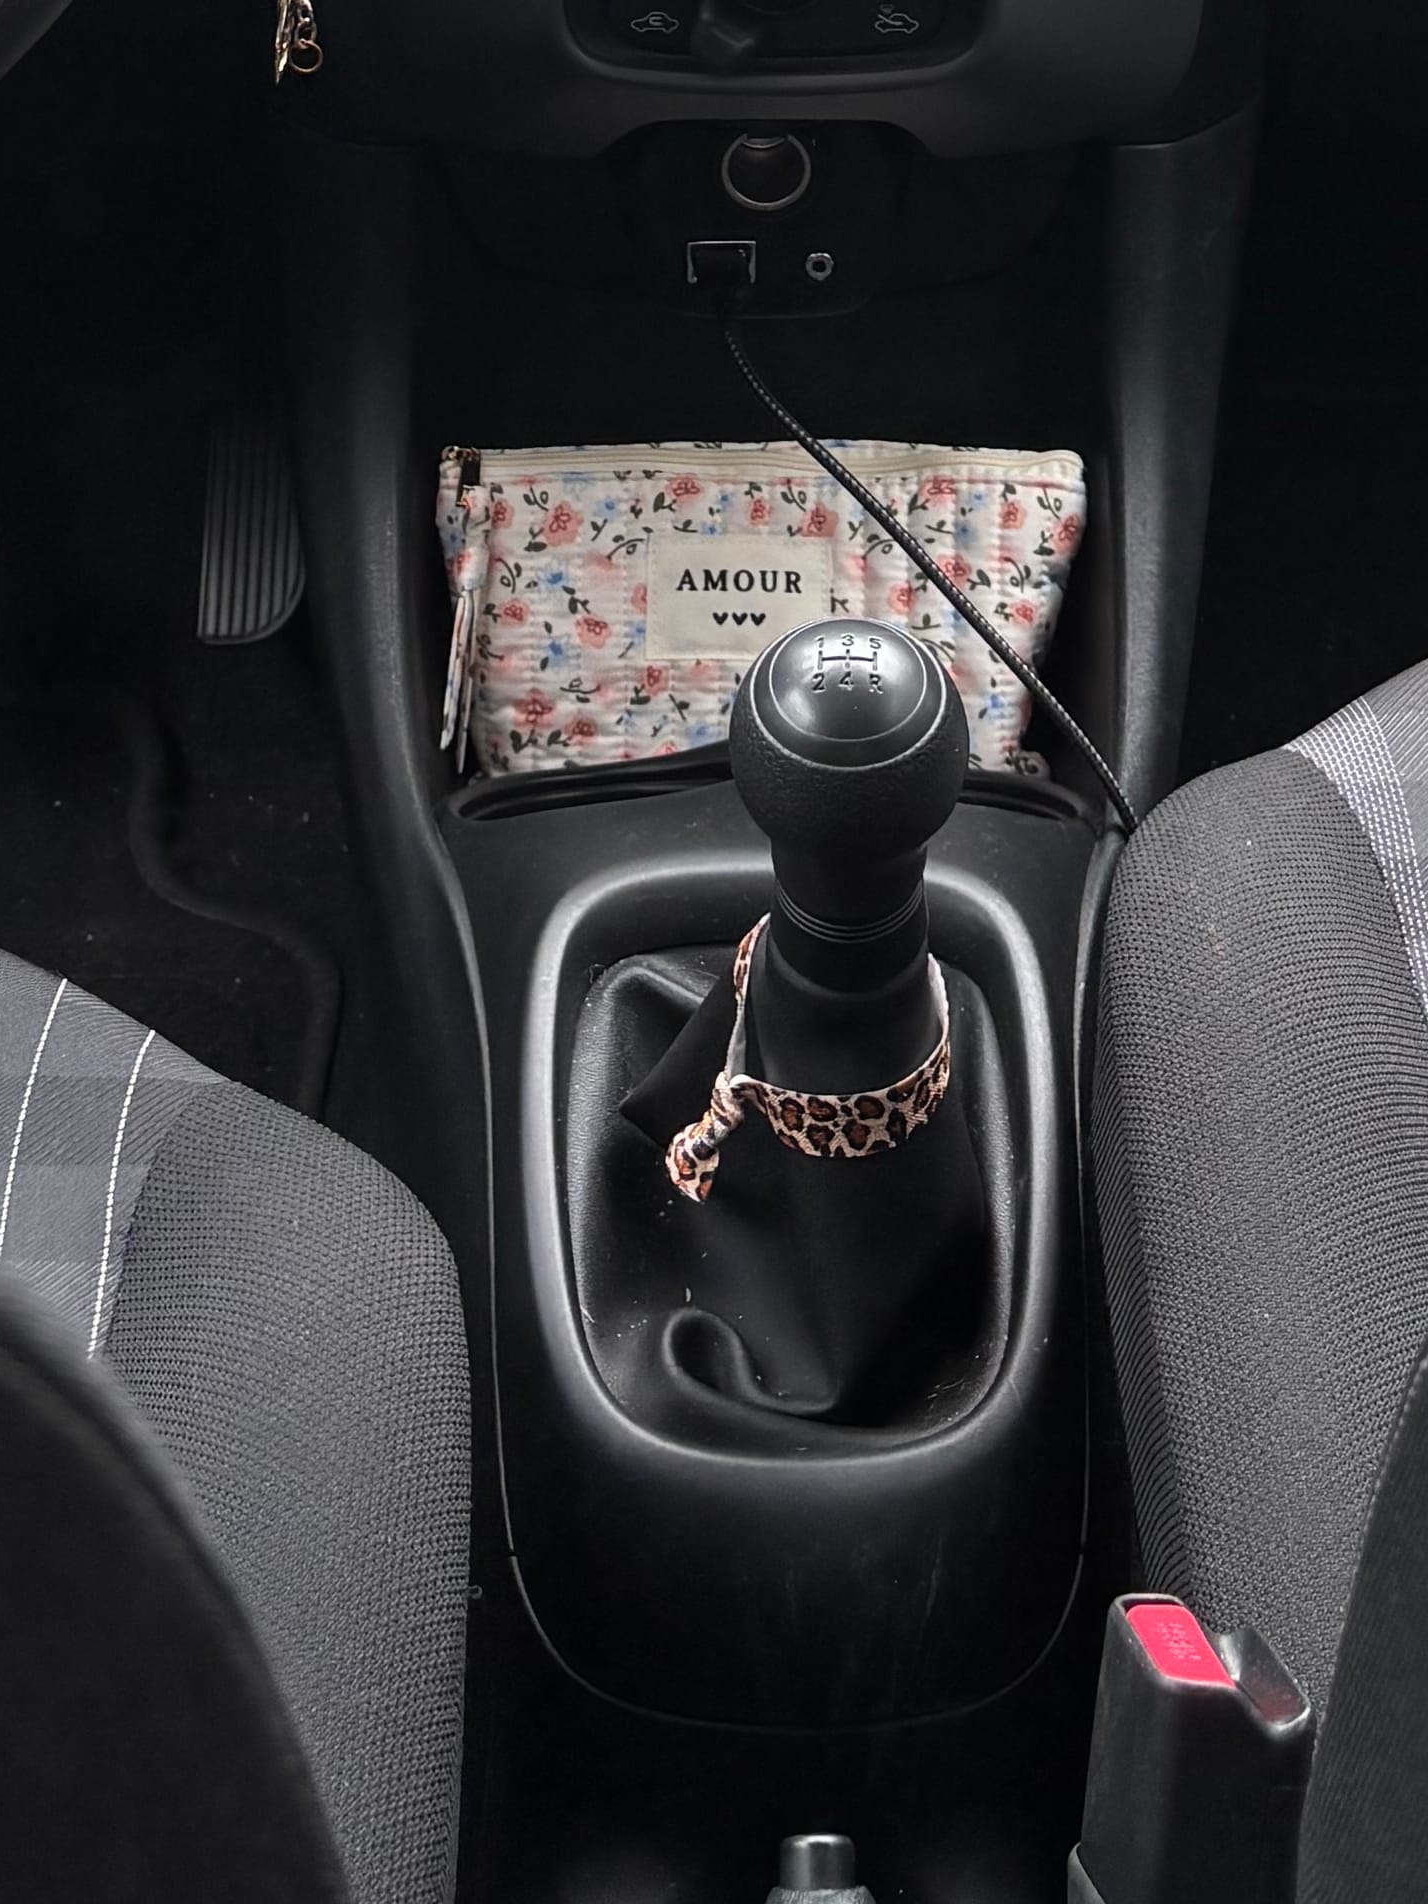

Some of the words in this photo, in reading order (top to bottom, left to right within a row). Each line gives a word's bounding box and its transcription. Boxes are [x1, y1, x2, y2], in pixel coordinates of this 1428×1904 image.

[675, 568, 803, 594] AMOUR
[816, 636, 825, 648] 1
[840, 633, 855, 647] 3
[868, 636, 882, 650] 5
[811, 672, 826, 692] 2
[838, 671, 855, 690] 4
[869, 673, 884, 694] R
